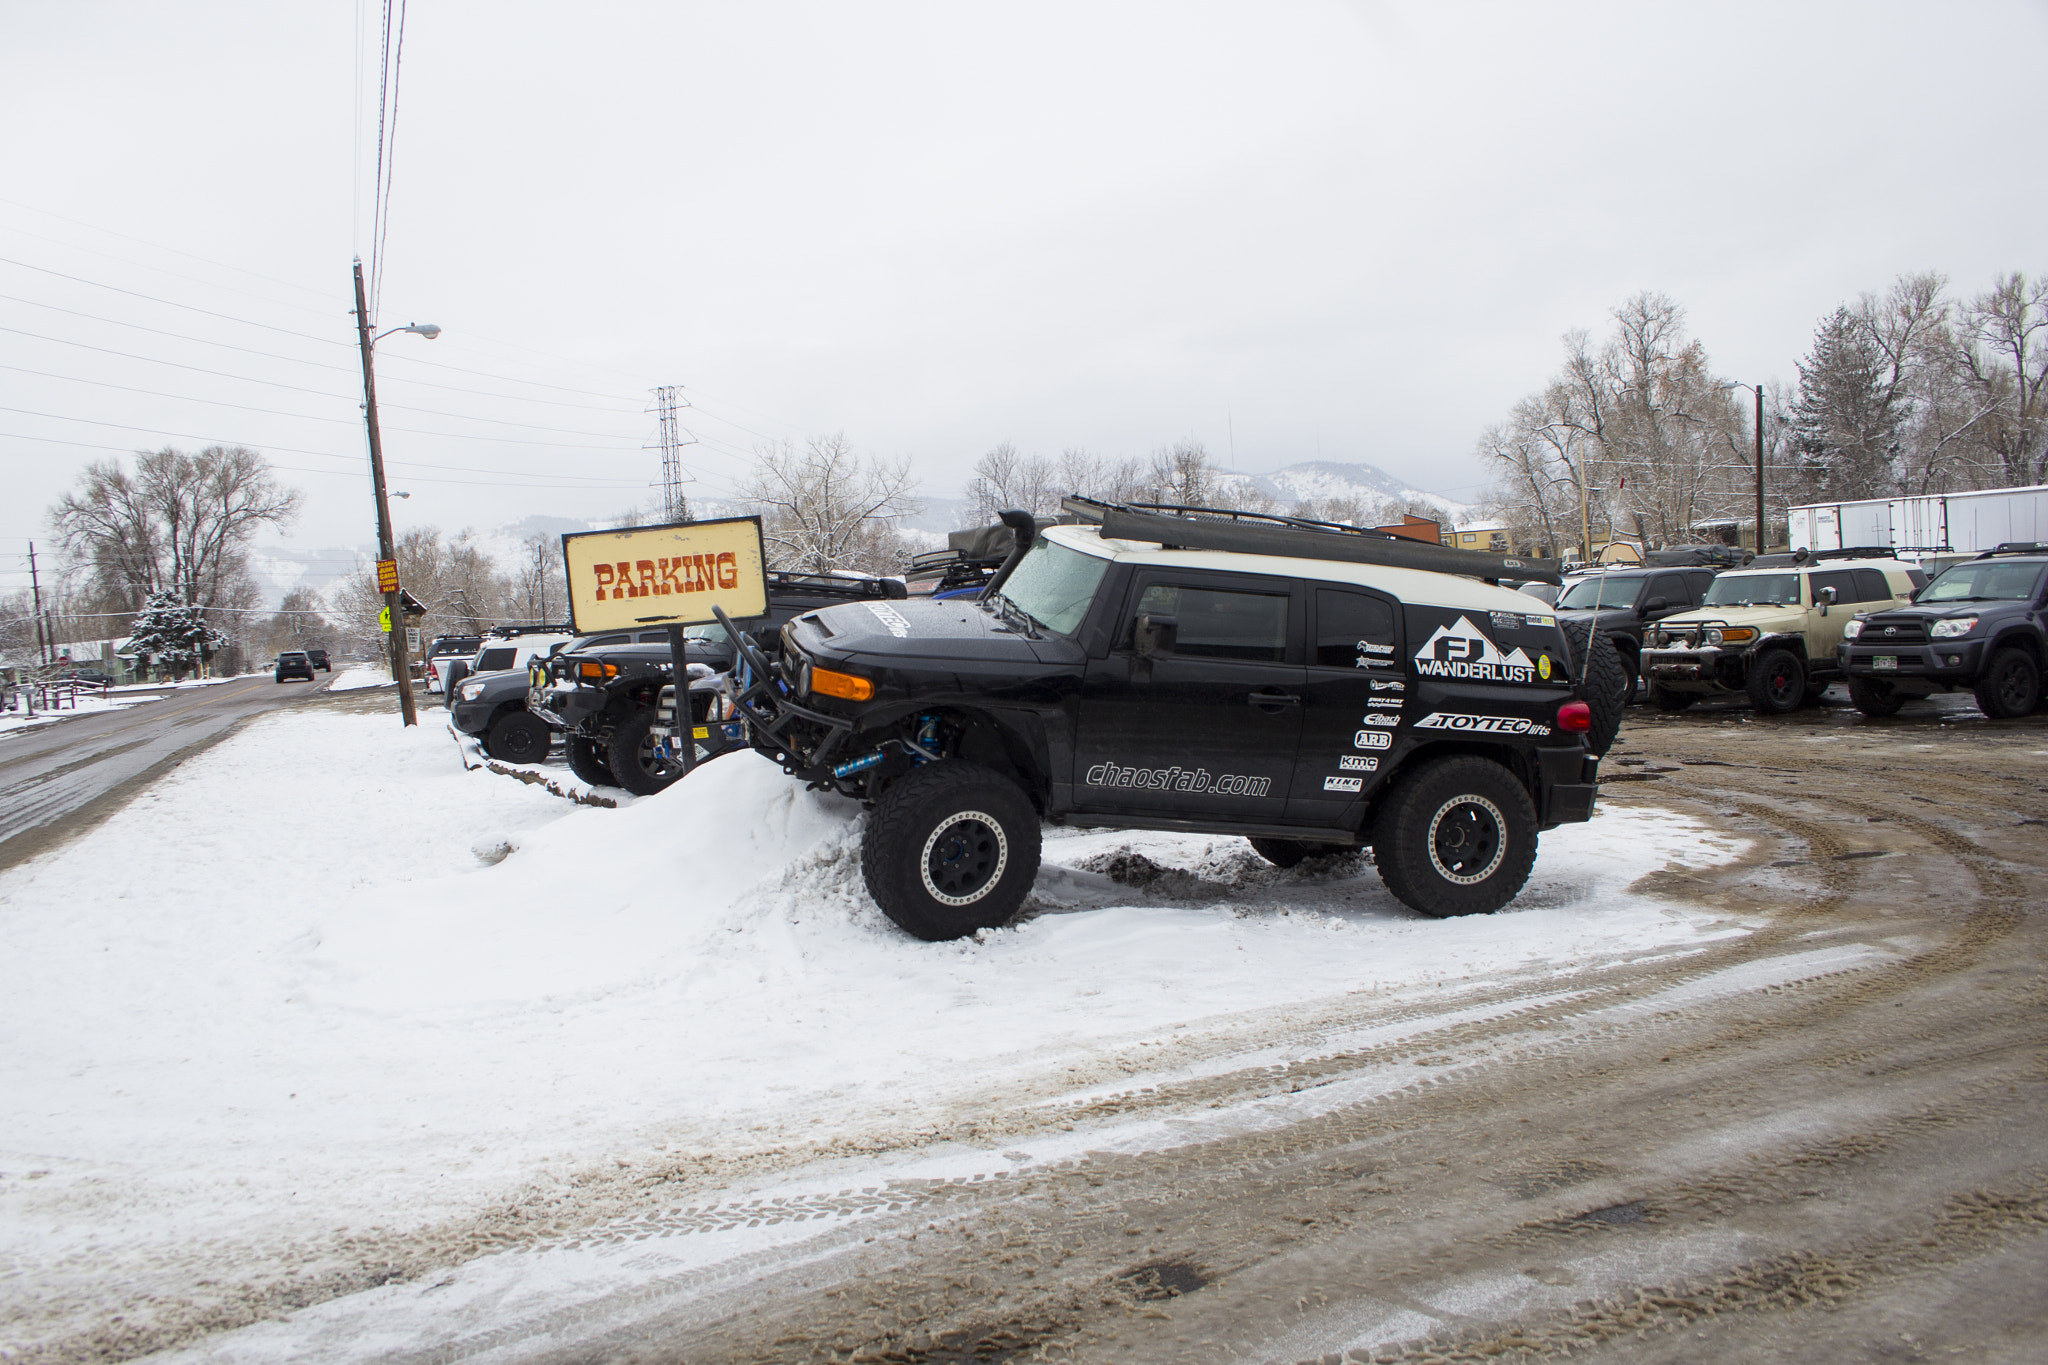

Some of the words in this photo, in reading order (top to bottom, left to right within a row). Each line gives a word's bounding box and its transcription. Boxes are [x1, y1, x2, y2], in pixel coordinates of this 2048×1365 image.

[593, 551, 738, 601] PARKING
[1414, 658, 1536, 683] WANDERLUST
[1364, 713, 1401, 725] Eibach
[1436, 713, 1531, 733] TOYTEC
[1528, 724, 1551, 735] lifts
[1358, 733, 1388, 747] ARB
[1086, 761, 1271, 797] chaosfab.com
[1327, 778, 1361, 786] KING
